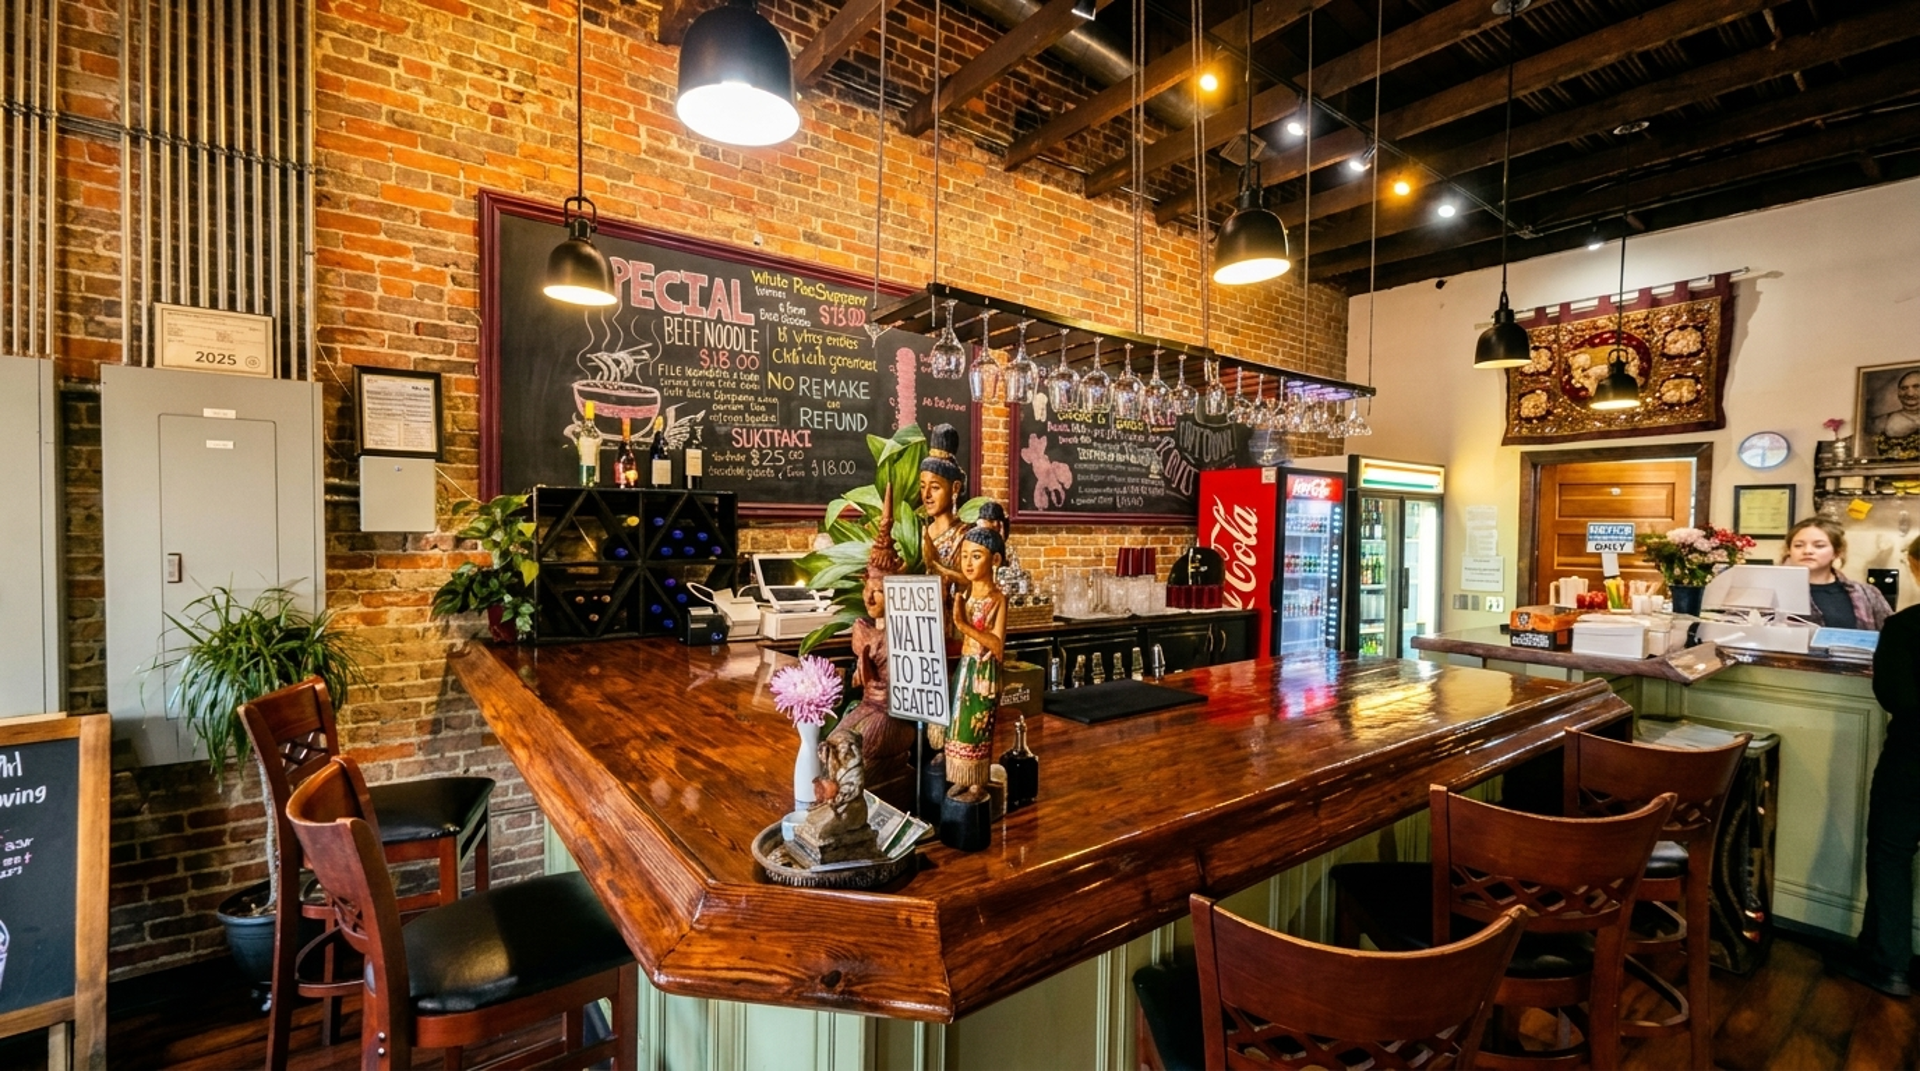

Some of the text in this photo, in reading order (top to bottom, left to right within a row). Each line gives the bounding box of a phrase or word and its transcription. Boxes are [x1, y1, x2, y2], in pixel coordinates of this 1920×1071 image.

[609, 256, 755, 326] PECIAL
[704, 323, 760, 354] NOODLE
[195, 350, 237, 366] 2025
[767, 371, 795, 392] No
[799, 376, 871, 400] REMAKE
[800, 407, 869, 433] REFUND
[1594, 543, 1626, 551] ONLY
[892, 654, 942, 687] TO BE
[892, 686, 944, 718] SEATED
[0, 784, 46, 808] ving
